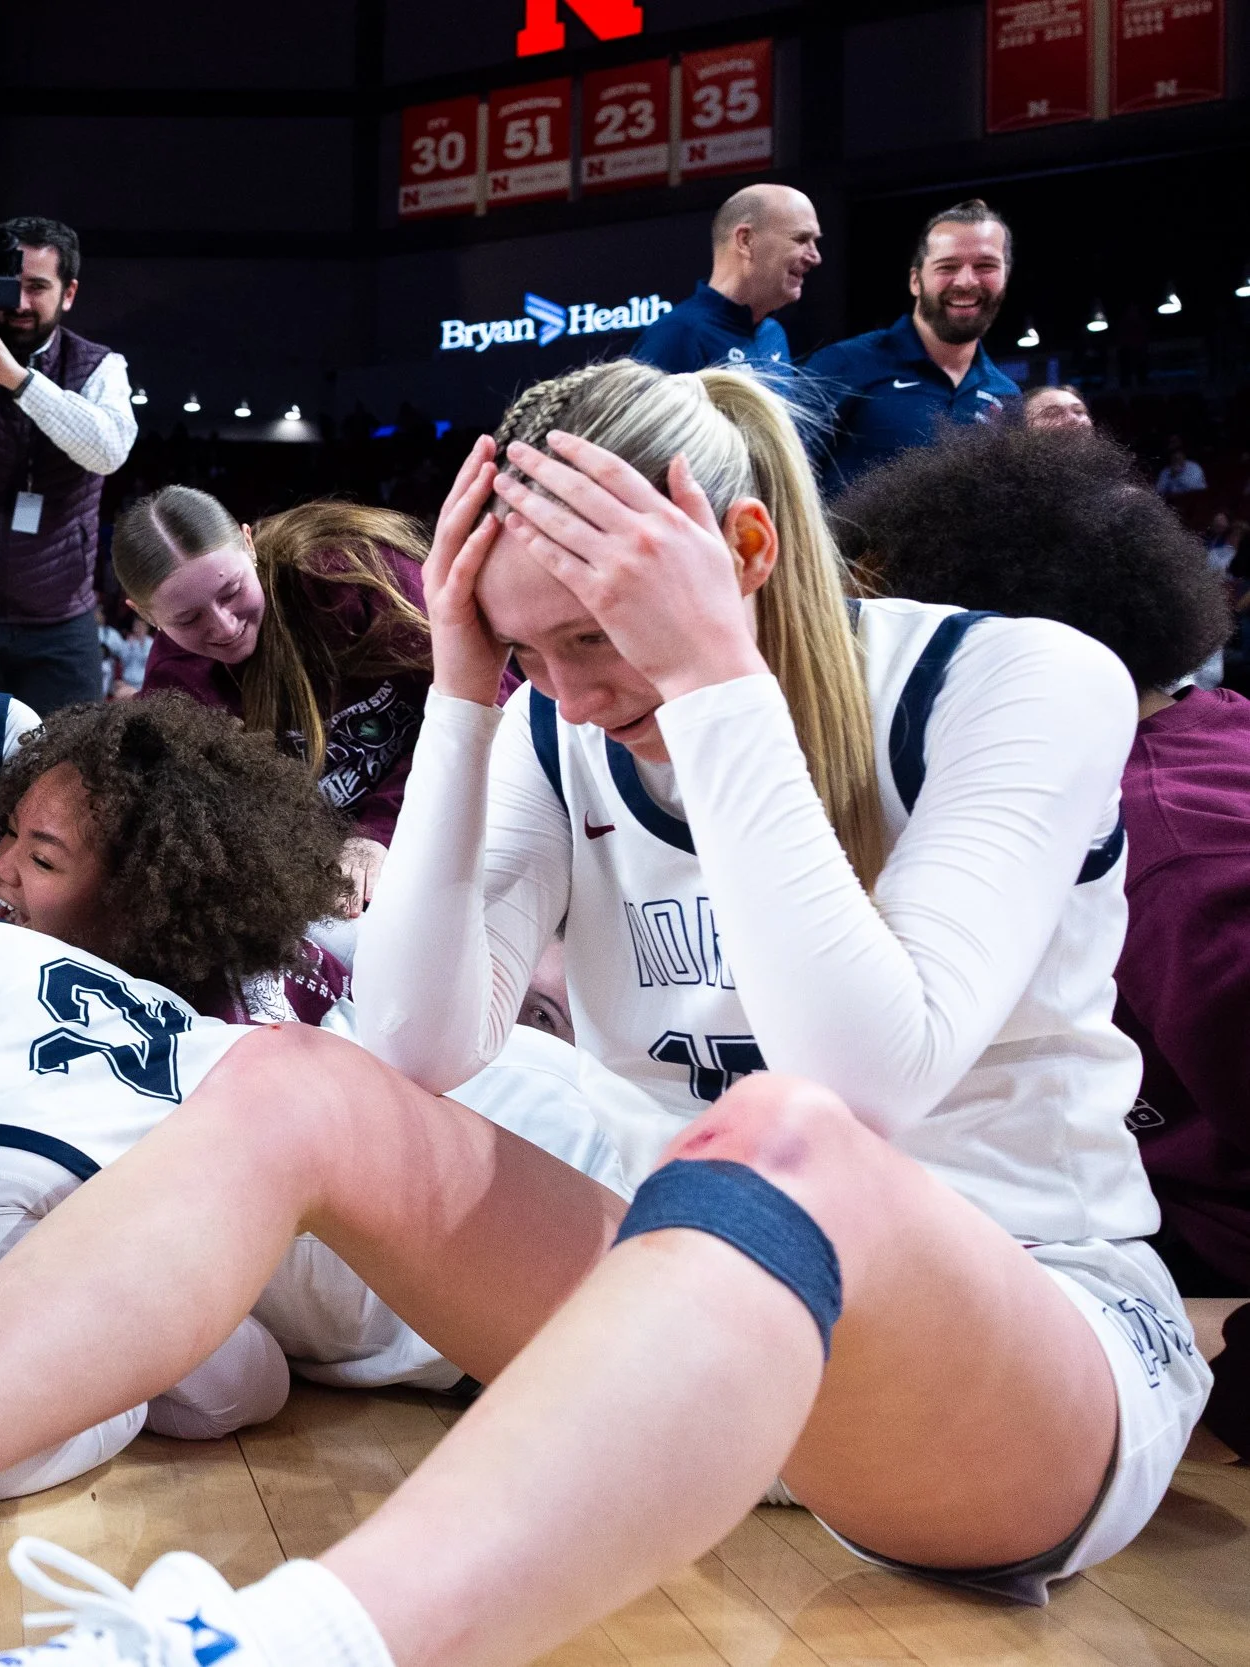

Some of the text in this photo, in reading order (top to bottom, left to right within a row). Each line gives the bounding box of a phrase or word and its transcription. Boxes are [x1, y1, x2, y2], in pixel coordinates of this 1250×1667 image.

[593, 98, 657, 146] 23
[691, 78, 761, 129] 35
[410, 131, 467, 176] 30
[503, 115, 553, 160] 51
[440, 294, 673, 353] Bryan Health
